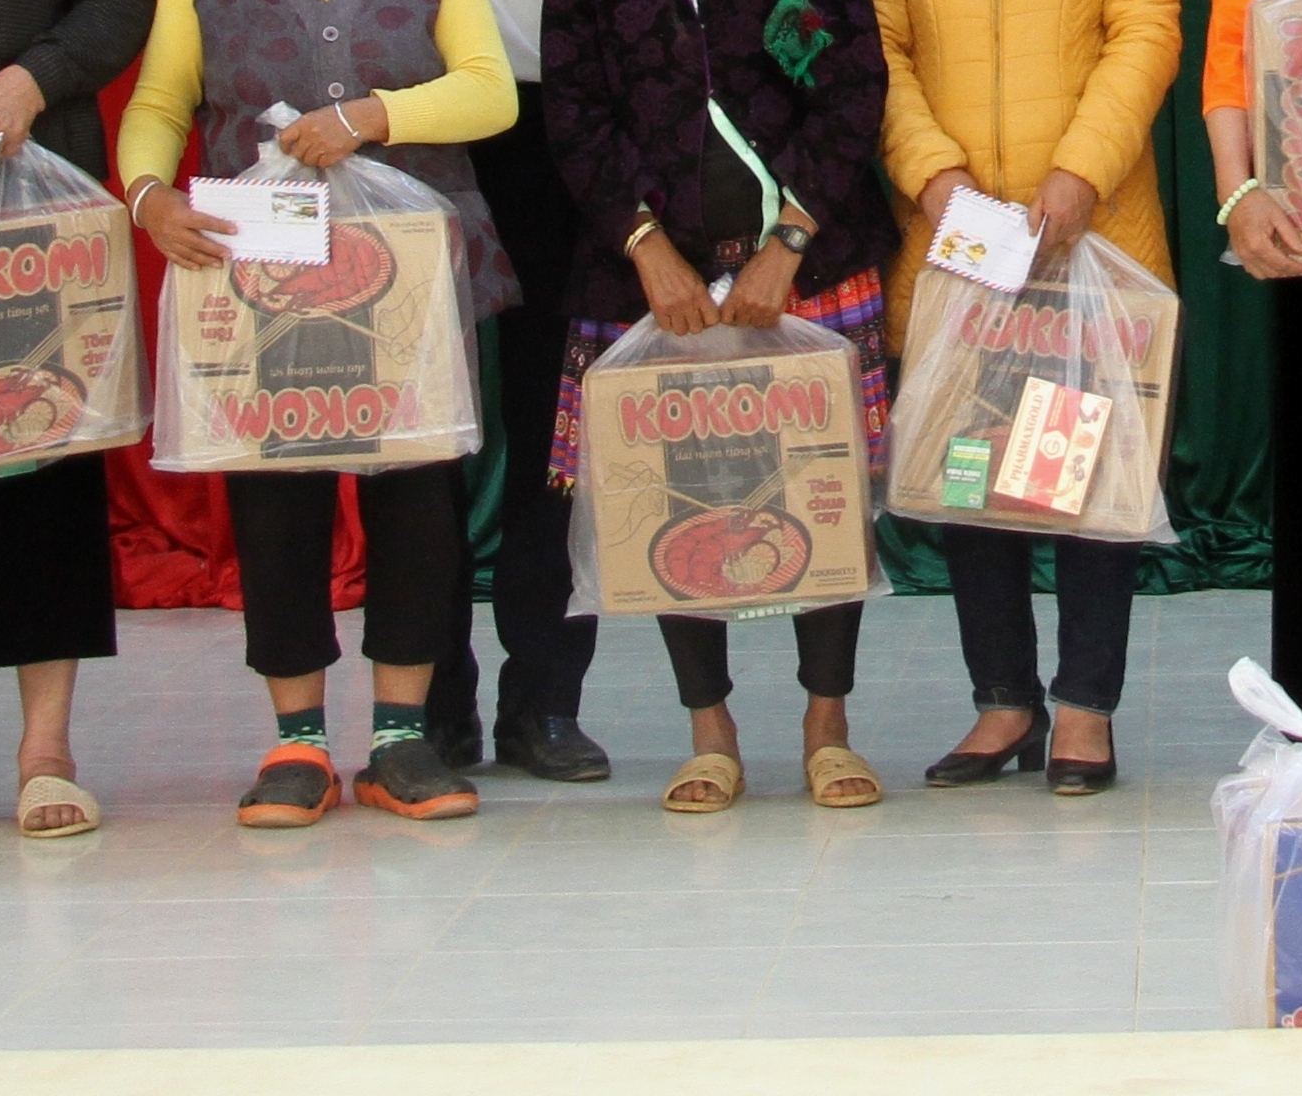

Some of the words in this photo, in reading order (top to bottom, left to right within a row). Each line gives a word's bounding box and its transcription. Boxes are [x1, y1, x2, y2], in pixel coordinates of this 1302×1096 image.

[209, 379, 421, 443] KOKOMI
[618, 376, 830, 446] KOKOMI
[1010, 393, 1045, 482] PHARMAXGOLD
